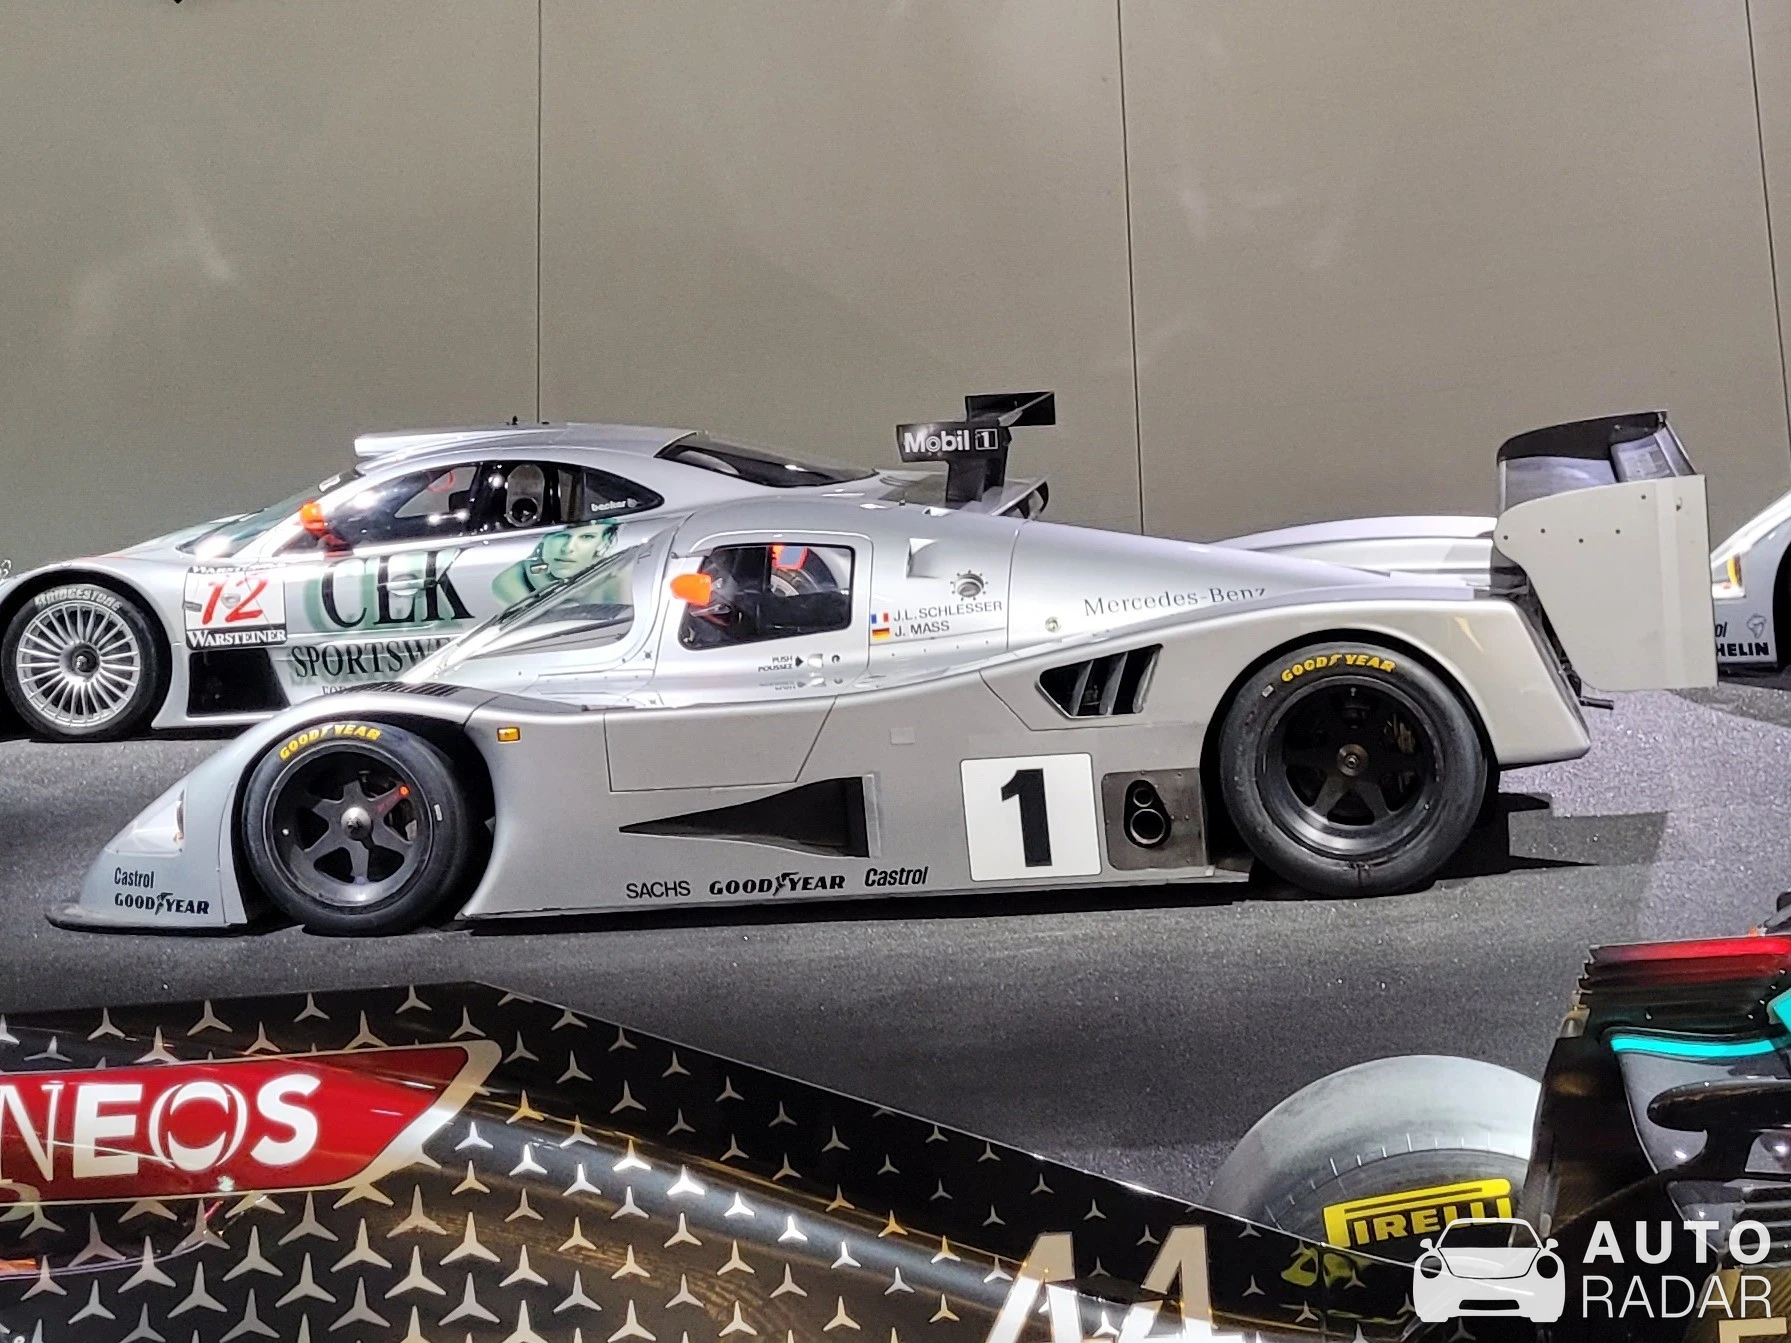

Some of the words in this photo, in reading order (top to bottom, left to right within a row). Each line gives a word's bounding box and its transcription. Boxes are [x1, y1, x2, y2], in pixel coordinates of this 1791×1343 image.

[904, 429, 970, 453] Mobil
[321, 549, 476, 628] CLK
[186, 629, 288, 648] WARSTEINER
[910, 620, 950, 636] MASS
[1001, 768, 1053, 867] 1
[114, 866, 155, 889] Castrol
[864, 866, 929, 888] Castrol
[625, 880, 692, 900] SACHS
[1323, 1178, 1513, 1248] PIRELLI
